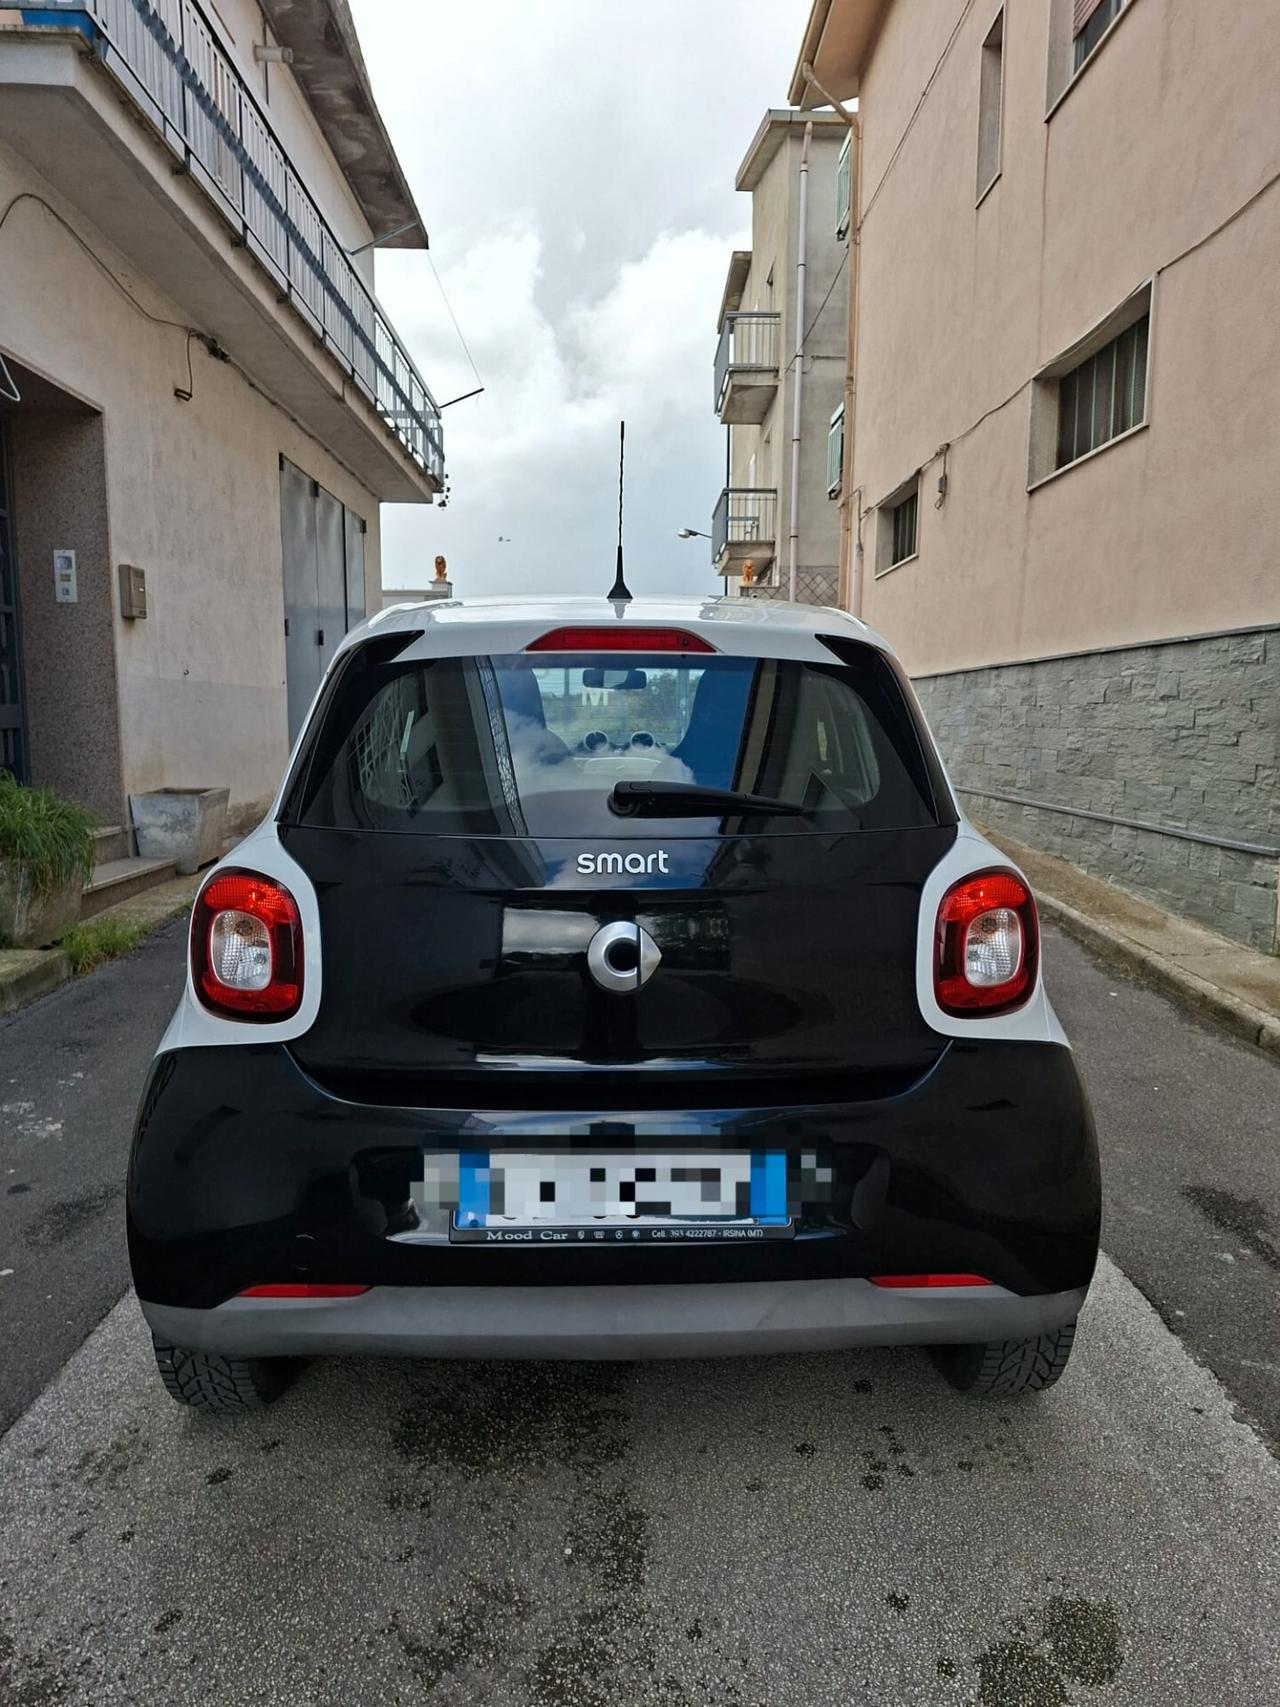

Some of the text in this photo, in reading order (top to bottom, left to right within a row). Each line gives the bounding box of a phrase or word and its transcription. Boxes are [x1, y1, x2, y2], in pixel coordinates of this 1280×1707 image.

[576, 849, 669, 874] smart
[486, 1231, 533, 1240] Mood
[540, 1231, 569, 1240] Car
[723, 1228, 746, 1238] IRSINA
